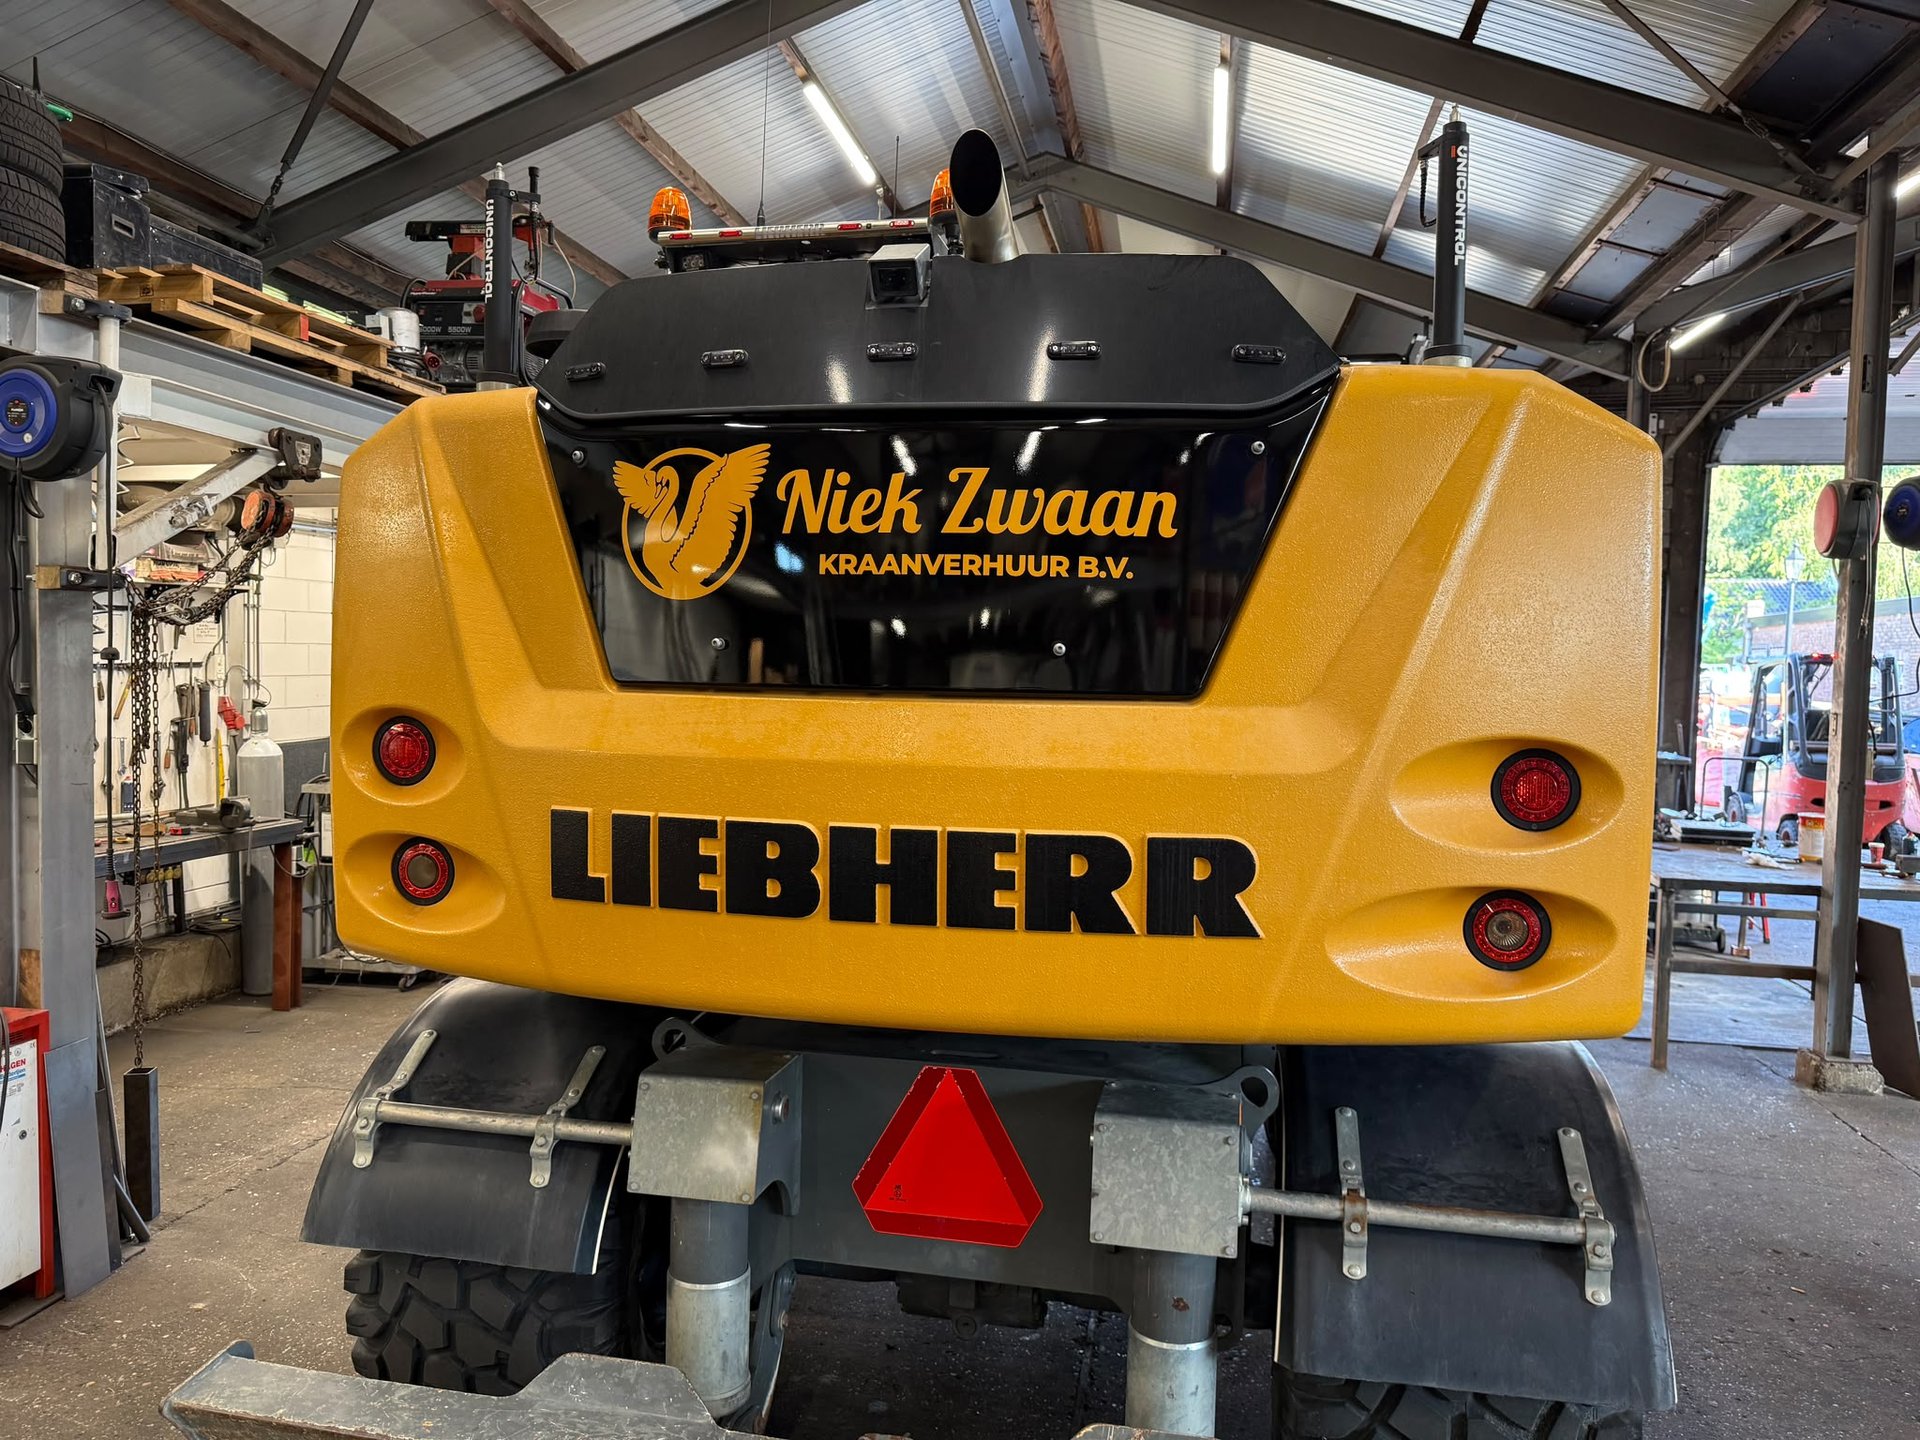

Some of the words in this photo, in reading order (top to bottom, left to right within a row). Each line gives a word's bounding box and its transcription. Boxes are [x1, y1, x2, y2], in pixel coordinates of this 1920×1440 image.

[1454, 145, 1468, 266] UNICONTROL
[485, 199, 495, 304] UNICONTROL
[447, 326, 472, 334] 5500W
[776, 468, 923, 534] Niek
[941, 467, 1178, 538] Zwaan
[818, 553, 1071, 578] KRAANVERHUUR
[1078, 556, 1134, 580] B.V.
[551, 807, 1263, 938] LIEBHERR
